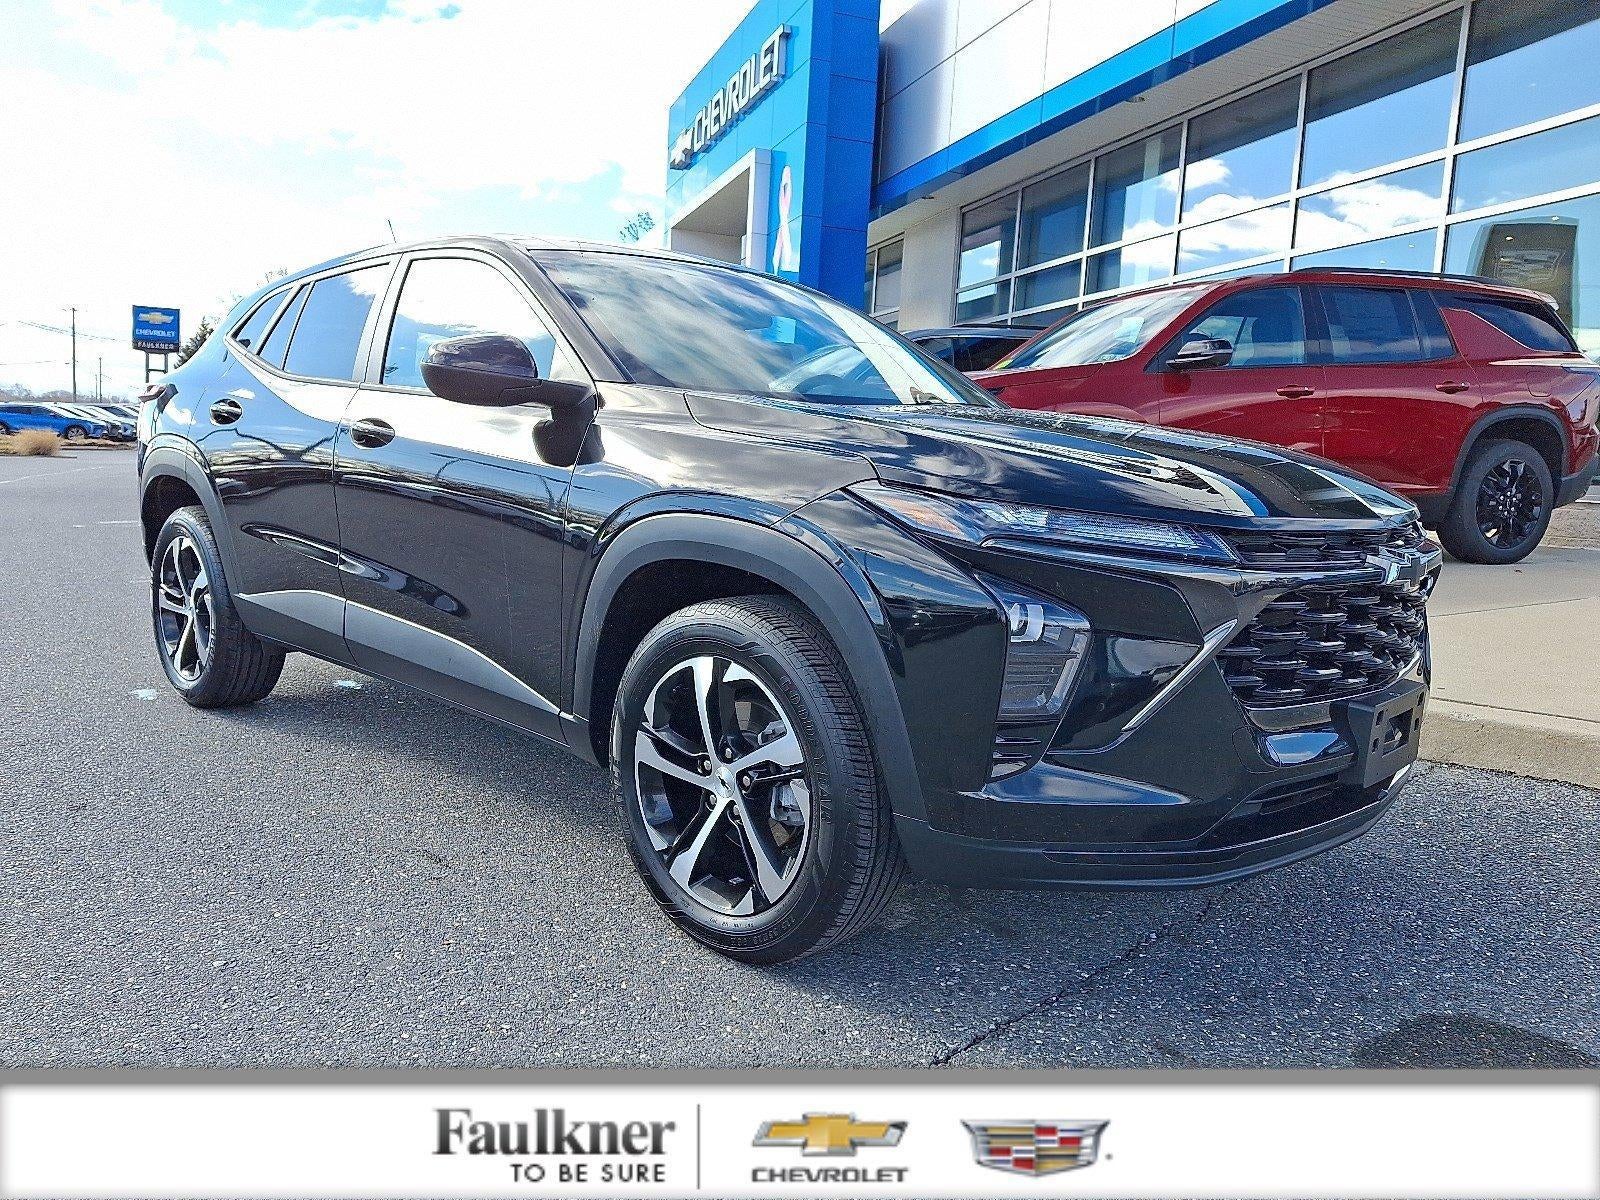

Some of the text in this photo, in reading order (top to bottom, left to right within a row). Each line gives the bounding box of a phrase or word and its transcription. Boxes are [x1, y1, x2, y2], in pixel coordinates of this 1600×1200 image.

[693, 23, 791, 153] CHEVROLET
[135, 328, 176, 338] CHEVROLET
[137, 341, 174, 350] FAULKNER
